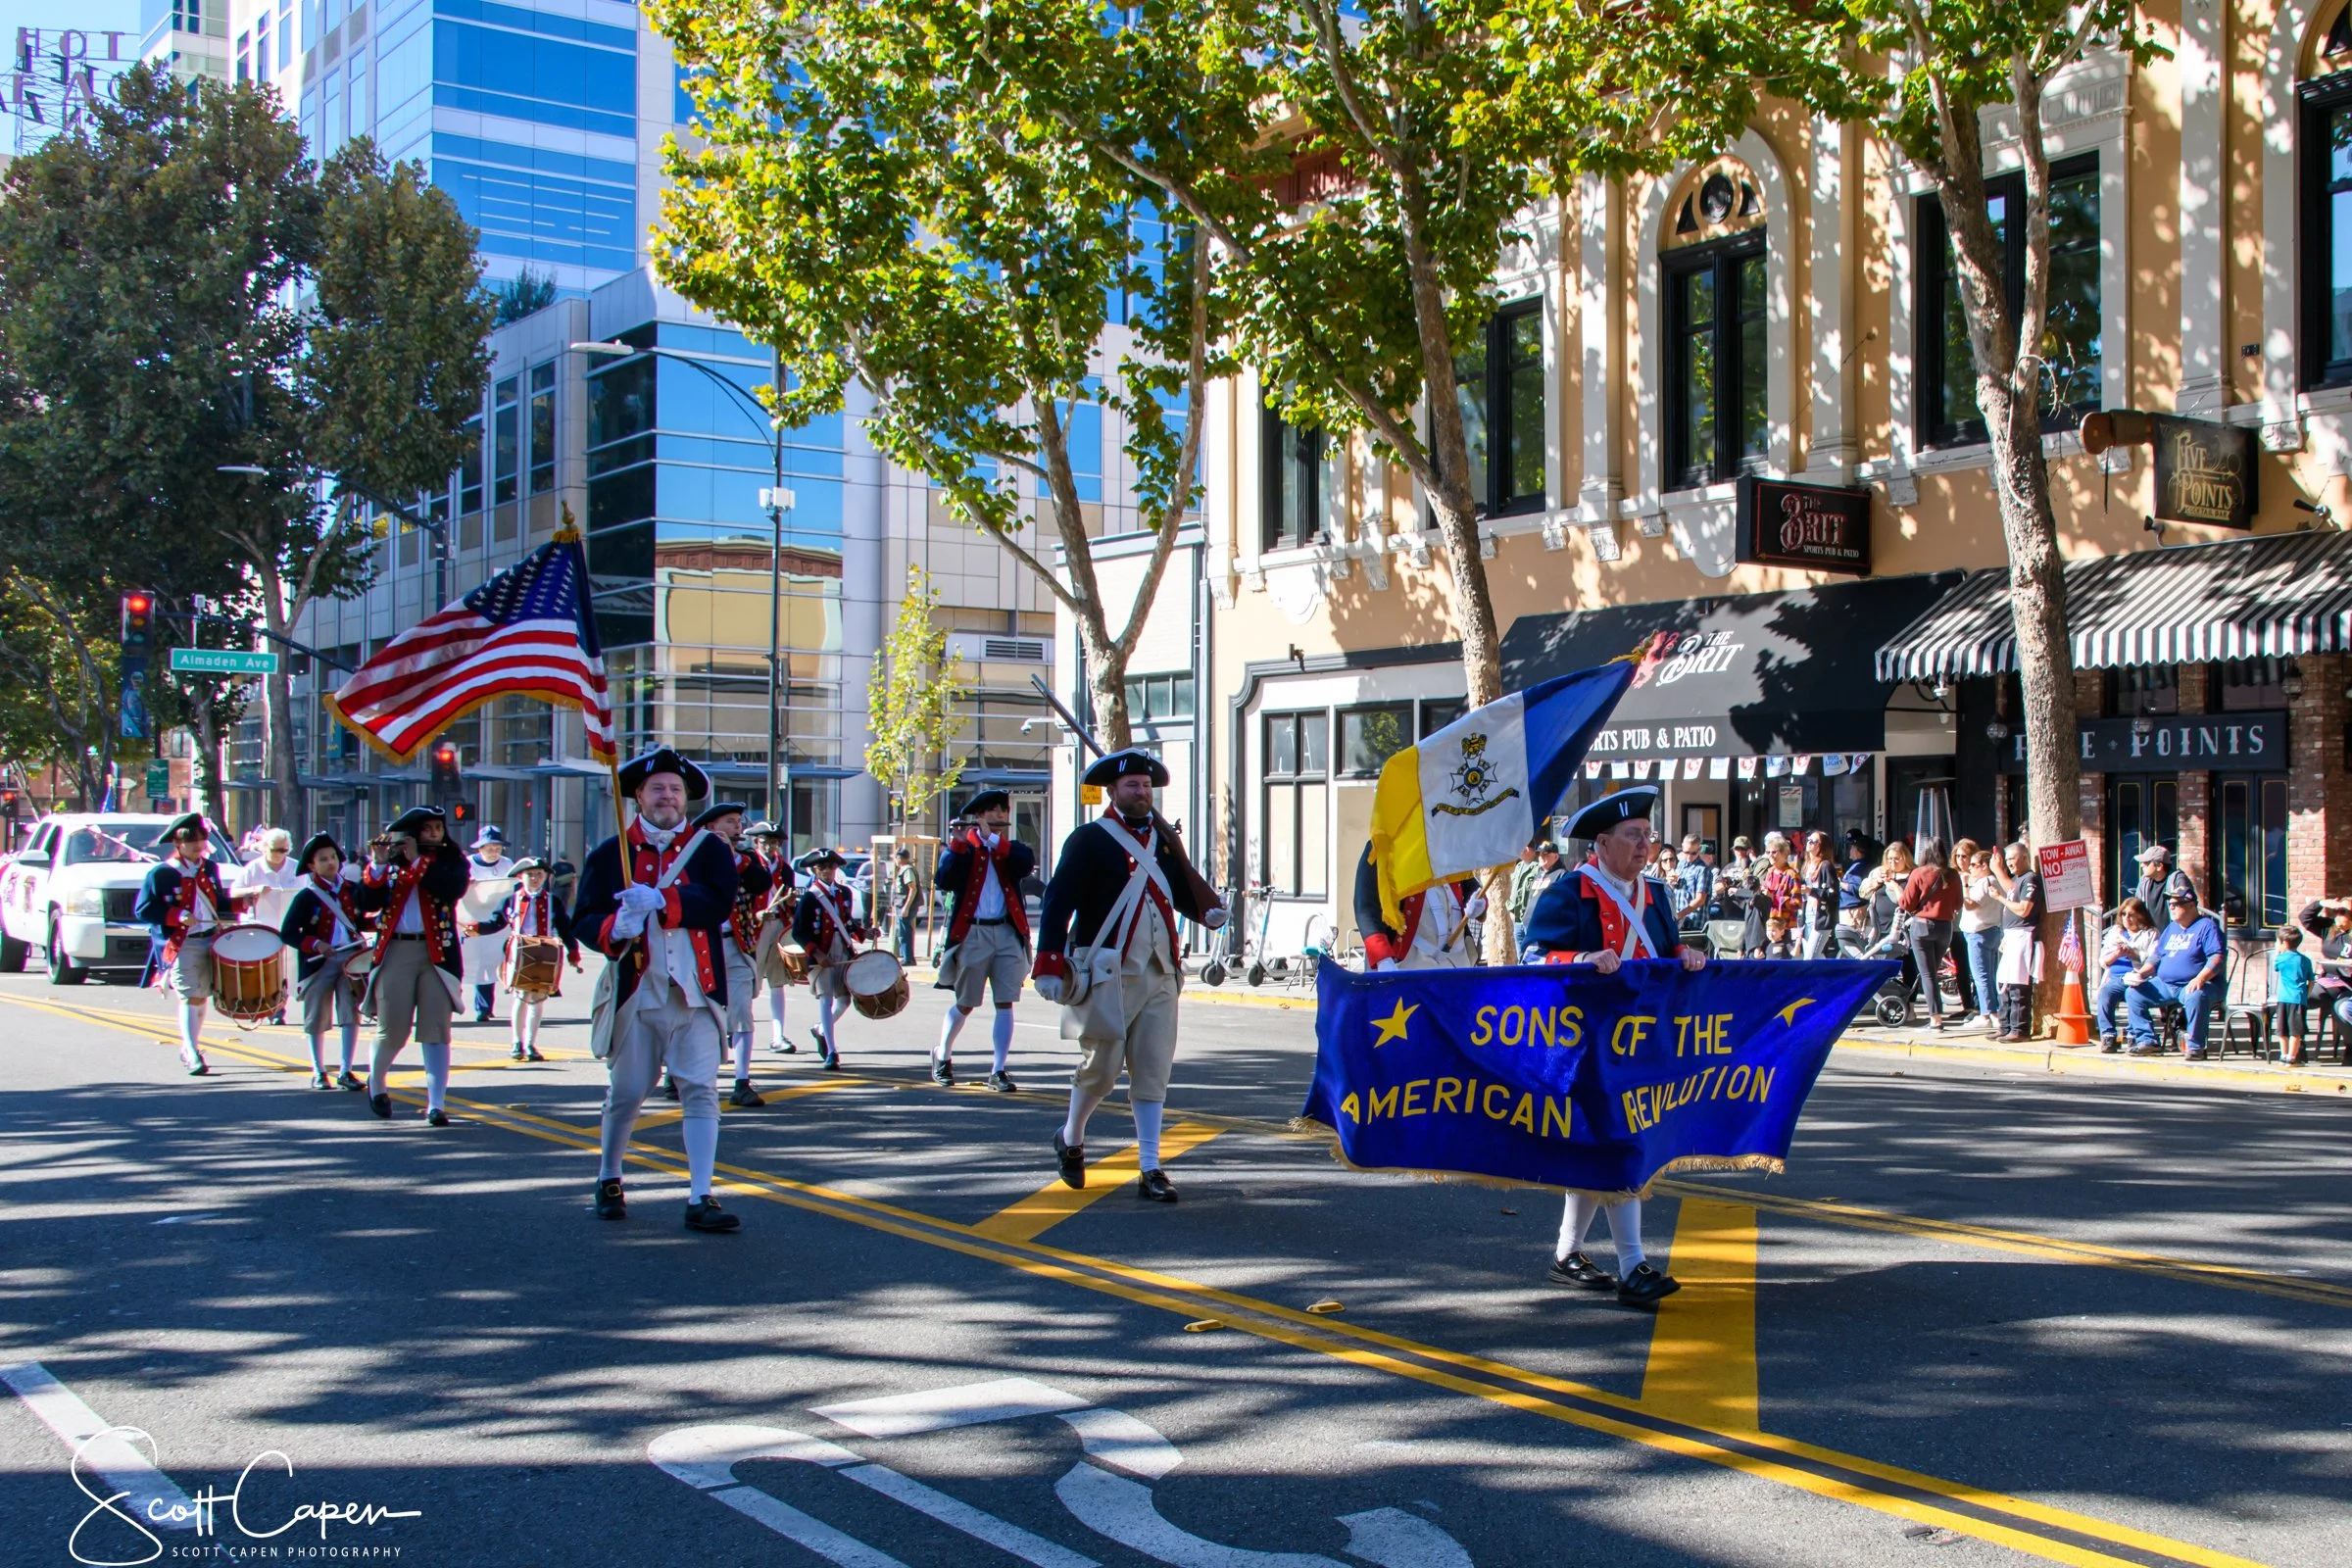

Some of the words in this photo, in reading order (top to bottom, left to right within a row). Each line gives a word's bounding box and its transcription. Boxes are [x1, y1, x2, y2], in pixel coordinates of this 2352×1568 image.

[17, 27, 124, 61] HOT
[2175, 430, 2207, 470] FIVE
[2177, 470, 2232, 513] POINTS
[1780, 493, 1845, 552] BRIT
[1803, 545, 1823, 555] SPORTS
[1825, 547, 1837, 556] PUB
[1843, 549, 1860, 558] PATIO
[1705, 631, 1734, 646] THE
[180, 655, 236, 667] Almaden
[245, 657, 270, 668] Ave
[1656, 634, 1744, 687] BRIT
[1589, 730, 1618, 752] RTS
[1622, 728, 1650, 751] PUB
[1656, 727, 1670, 749] &
[1674, 726, 1716, 748] PATIO
[2131, 725, 2264, 758] POINTS
[2041, 849, 2059, 860] TOW
[2065, 844, 2083, 857] AWAY
[2043, 862, 2061, 876] NO
[1470, 1005, 1584, 1048] SONS
[1611, 1015, 1657, 1056] OF
[1674, 1013, 1734, 1057] THE
[1341, 1077, 1571, 1139] AMERICAN
[1622, 1064, 1776, 1134] REVLUTION
